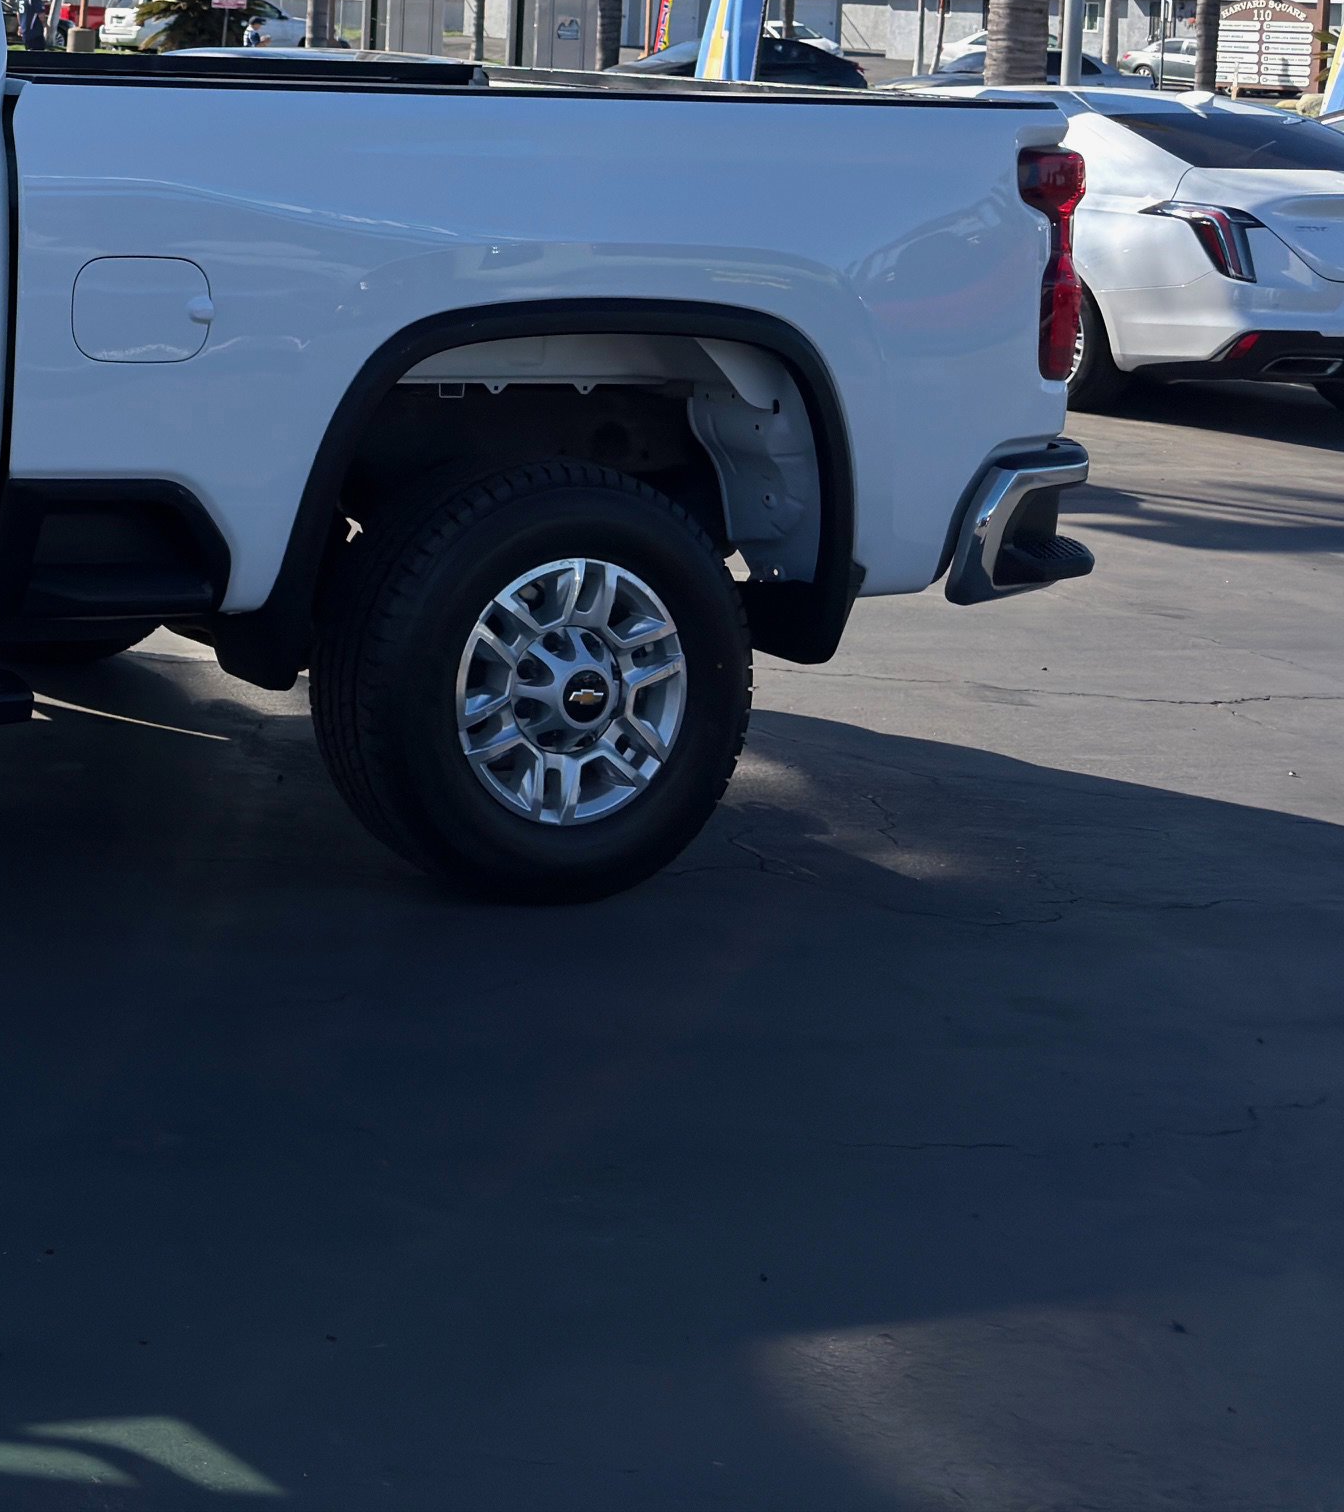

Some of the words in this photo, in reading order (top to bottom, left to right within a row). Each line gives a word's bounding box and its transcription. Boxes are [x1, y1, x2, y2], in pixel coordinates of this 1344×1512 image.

[1221, 0, 1267, 19] HARVARD
[1268, 0, 1307, 22] SQUARE
[1253, 10, 1273, 21] 110
